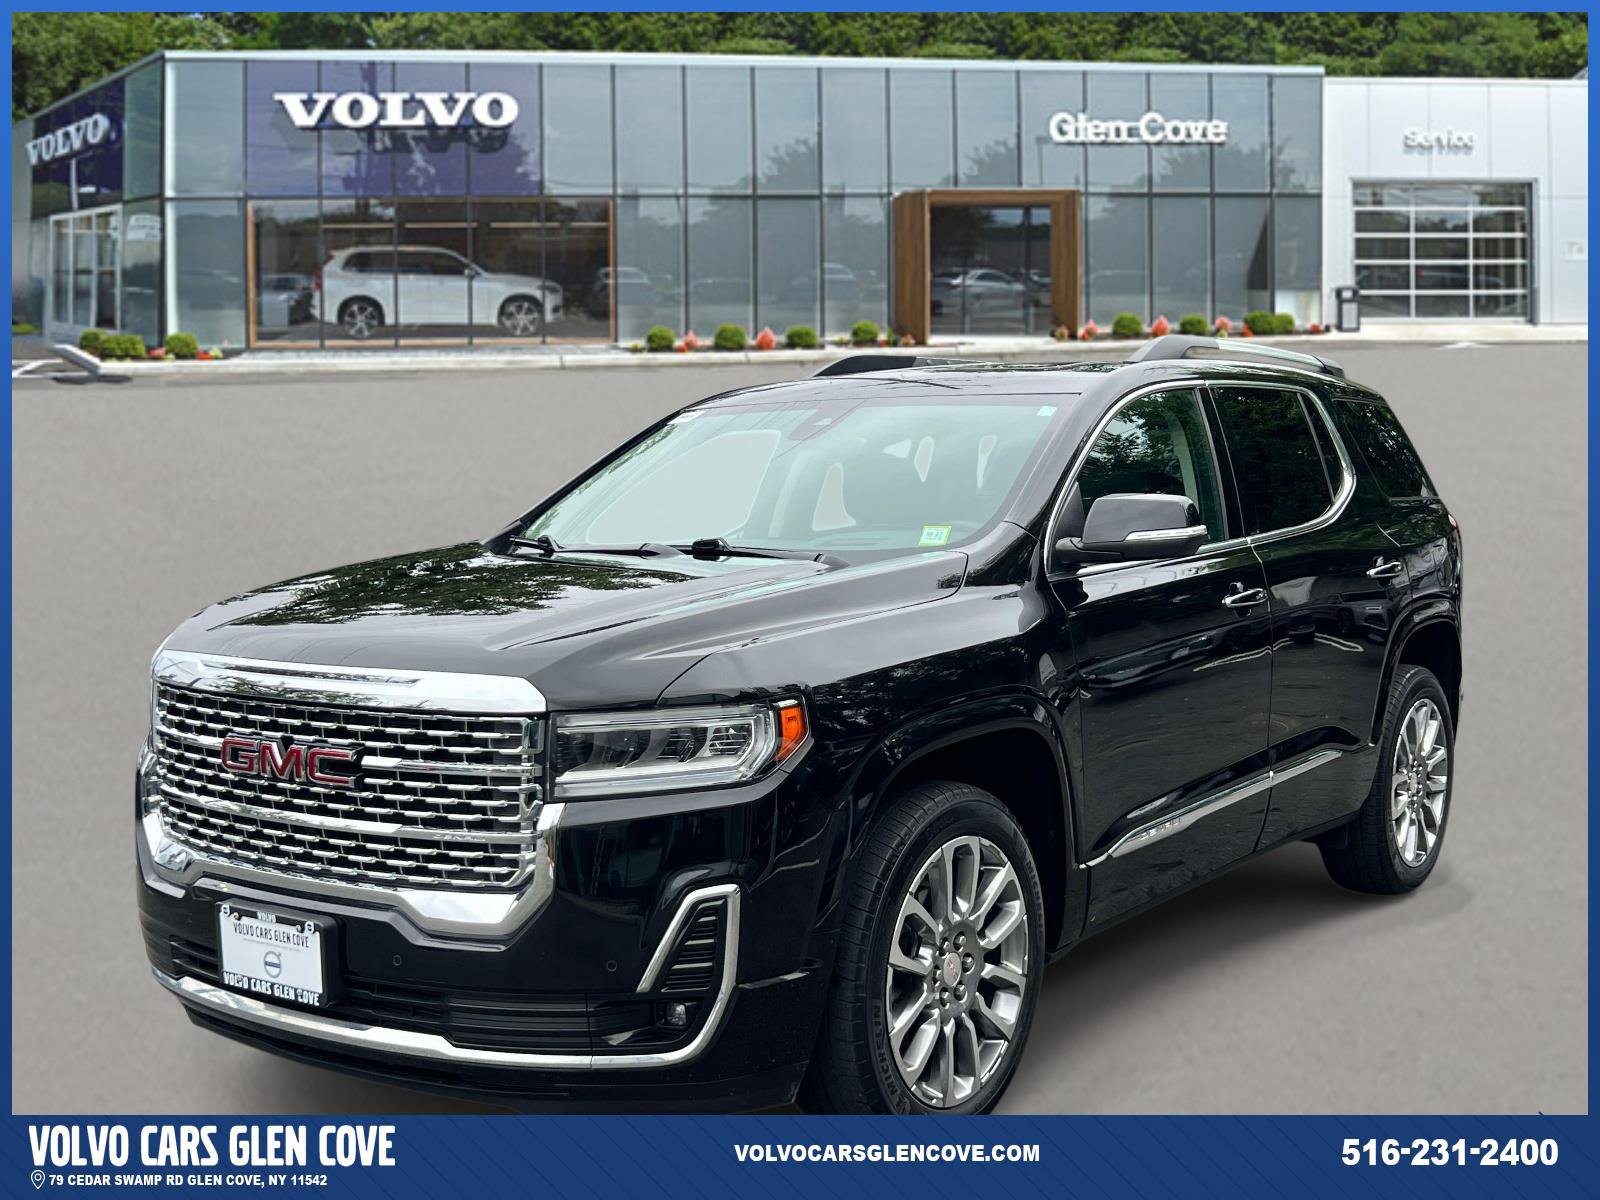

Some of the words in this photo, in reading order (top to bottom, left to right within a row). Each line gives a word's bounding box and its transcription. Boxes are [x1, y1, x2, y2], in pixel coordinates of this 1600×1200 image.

[273, 92, 519, 128] VOLVO
[1049, 112, 1132, 143] Glen
[1139, 112, 1229, 143] Cove
[25, 113, 110, 165] VOLVO
[1403, 128, 1475, 150] Service
[221, 735, 357, 788] GMC
[233, 921, 254, 937] VOLVO
[255, 926, 273, 941] CARS
[274, 930, 292, 944] GLEN
[292, 932, 310, 948] COVE
[257, 911, 276, 923] VOLVO
[223, 971, 249, 989] VOLVO
[251, 978, 272, 996] CARS
[274, 984, 295, 1000] GLEN
[296, 988, 320, 1006] COVE
[872, 1005, 899, 1096] MICHELIN
